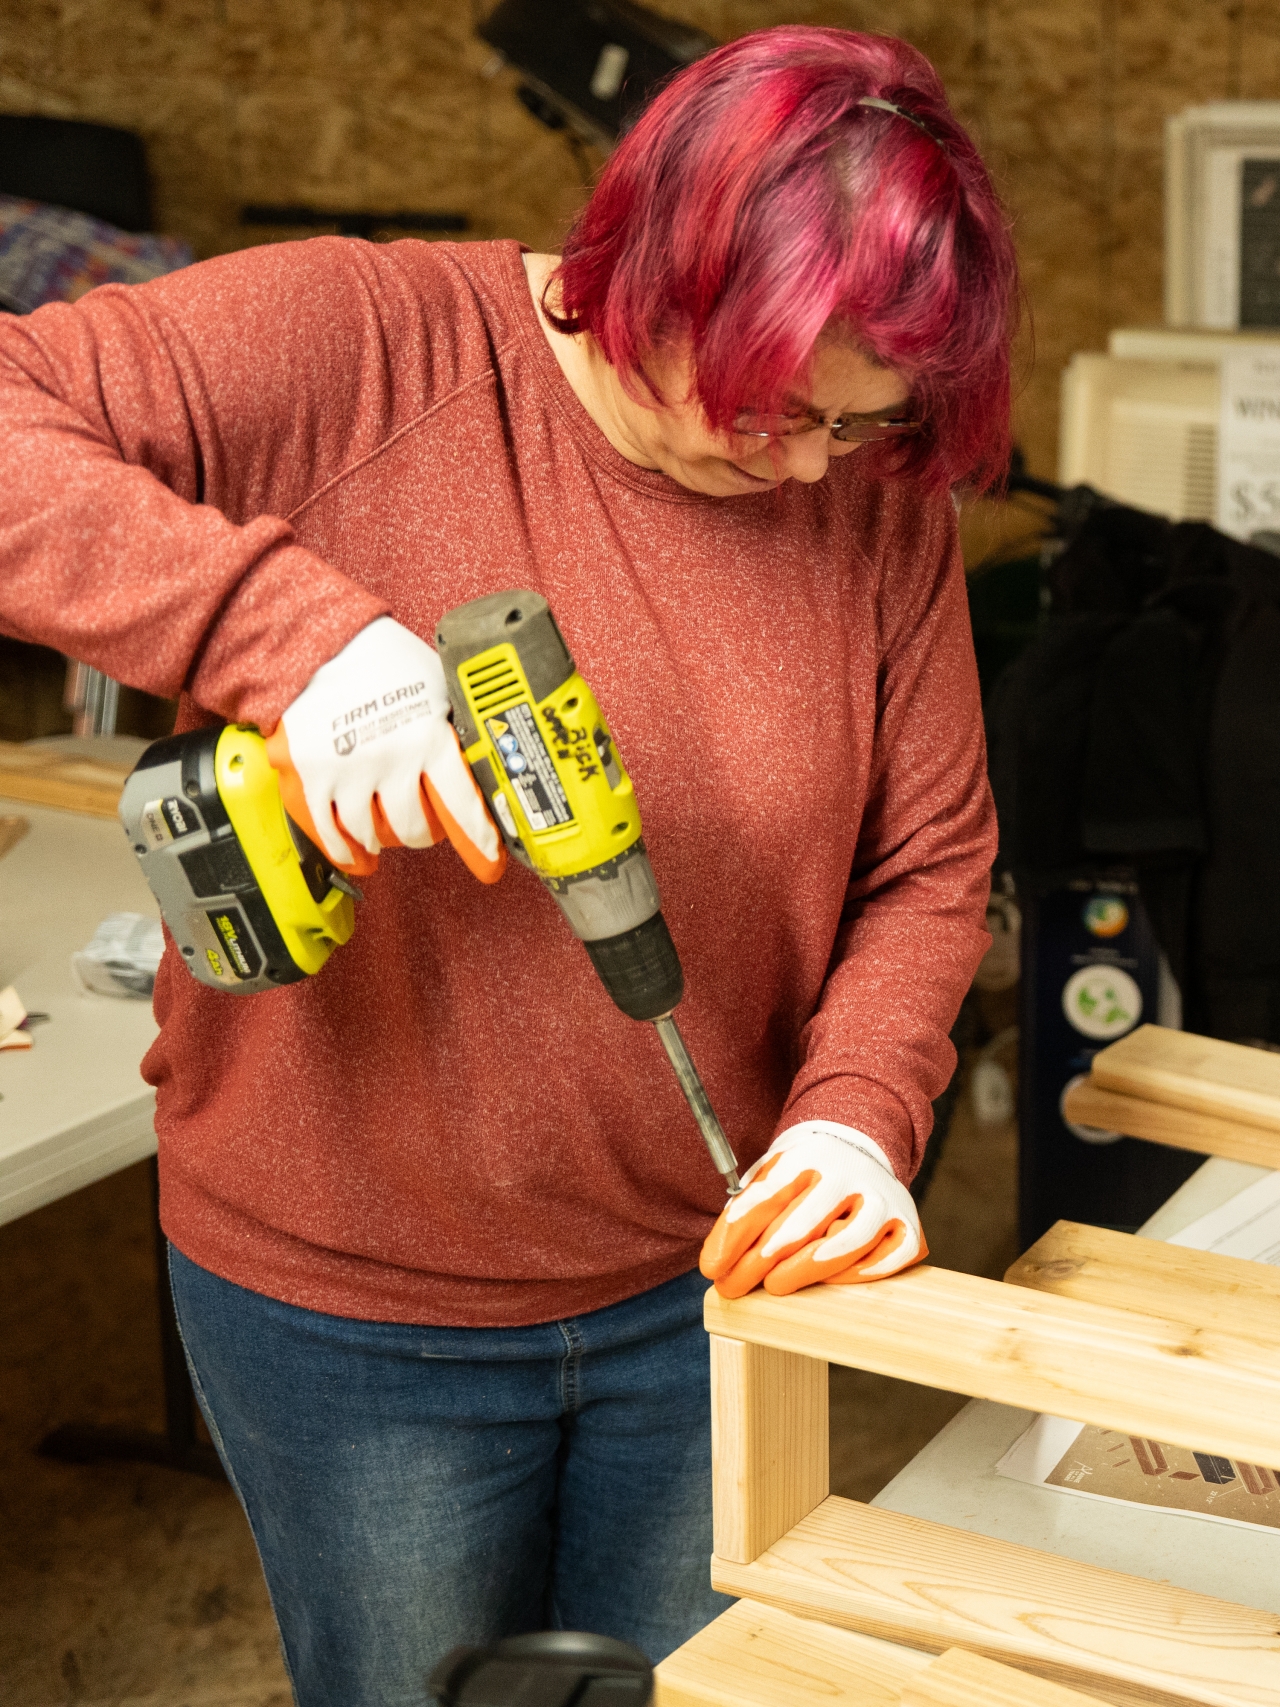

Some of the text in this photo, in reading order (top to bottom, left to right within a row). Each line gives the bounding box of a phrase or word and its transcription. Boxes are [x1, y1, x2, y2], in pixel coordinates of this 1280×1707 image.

[331, 699, 379, 732] FIRM
[382, 680, 426, 707] GRIP
[167, 799, 188, 833] RYOBI
